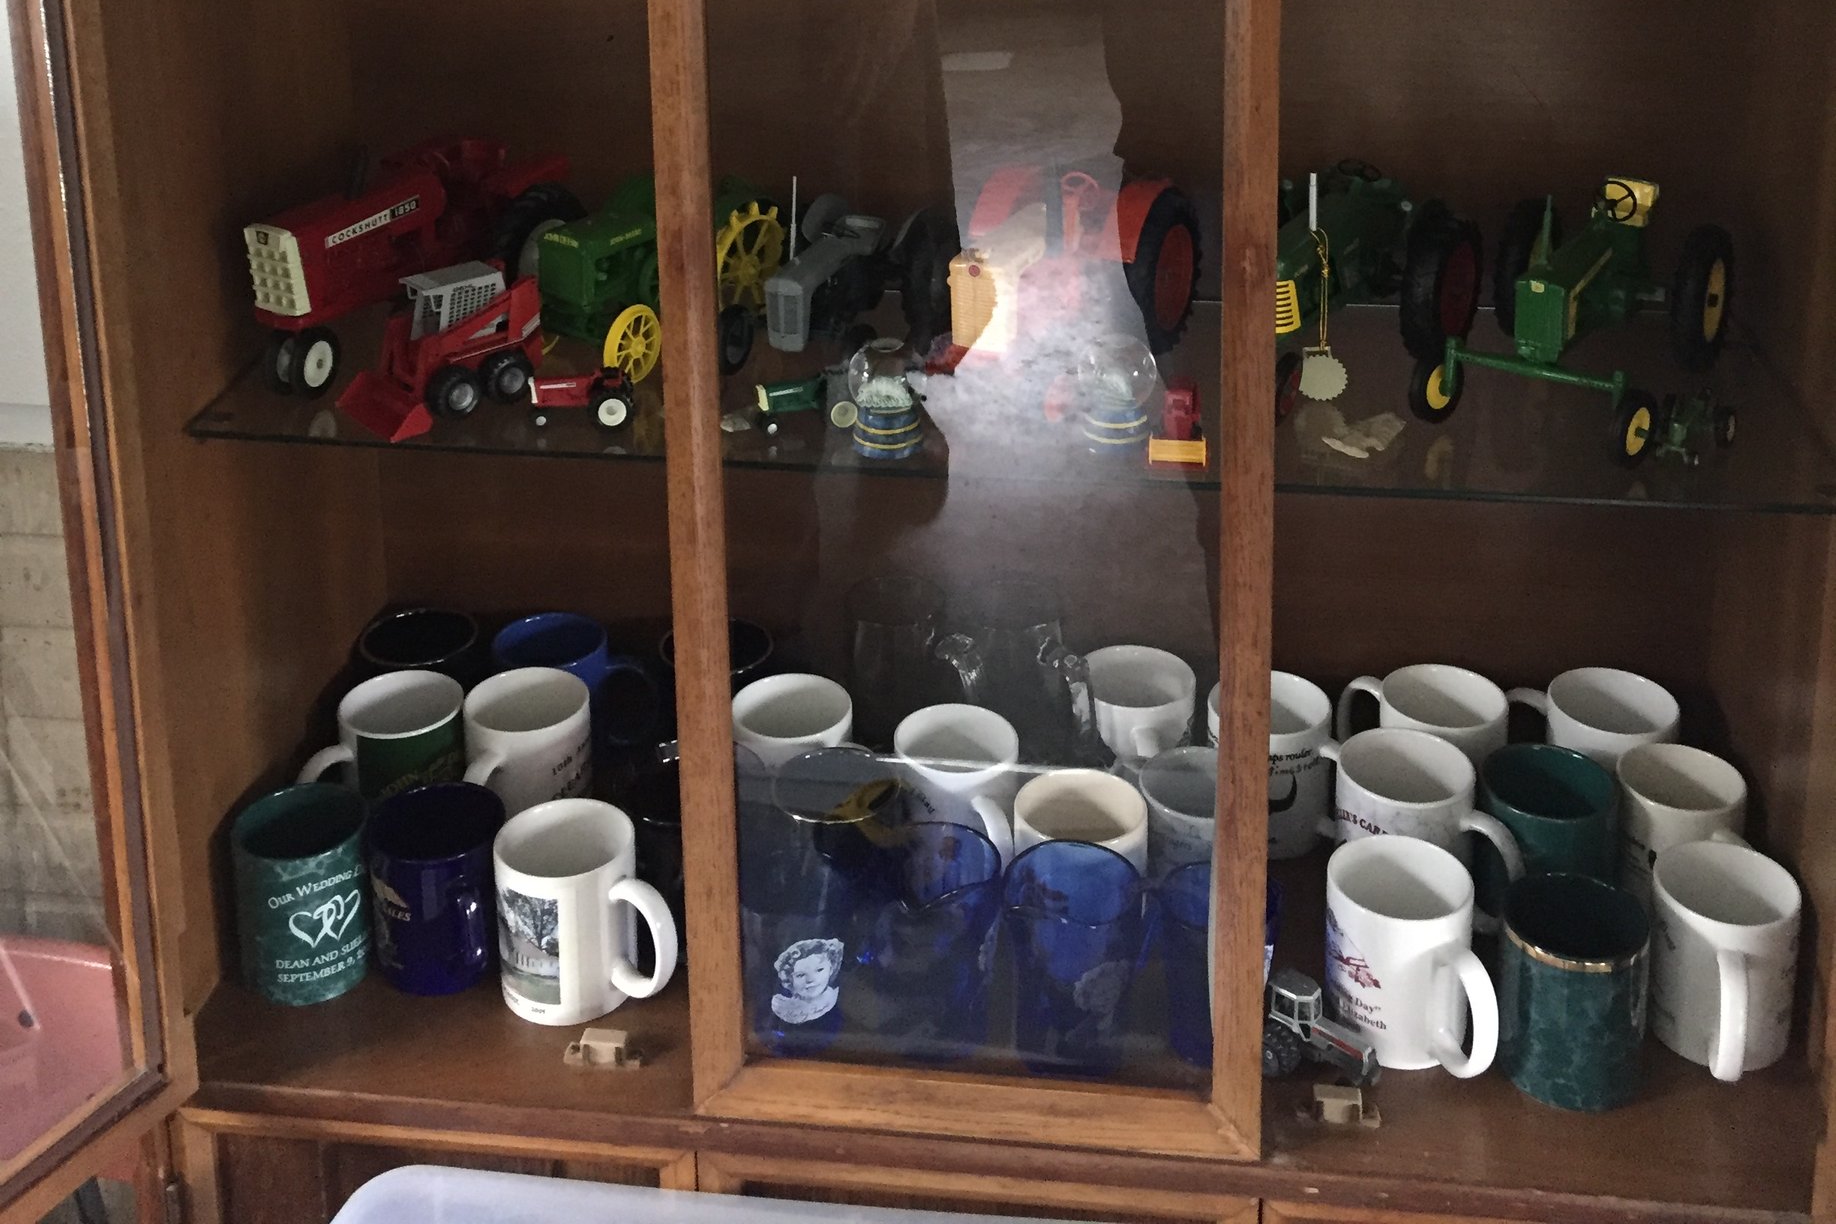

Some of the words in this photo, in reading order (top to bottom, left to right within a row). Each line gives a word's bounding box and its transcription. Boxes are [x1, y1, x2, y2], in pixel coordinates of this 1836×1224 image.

[331, 213, 389, 244] COCKSHUTT
[394, 200, 417, 217] 1850
[275, 958, 311, 970] DEAN
[312, 950, 339, 966] AND
[277, 961, 346, 983] SEPTEMBER
